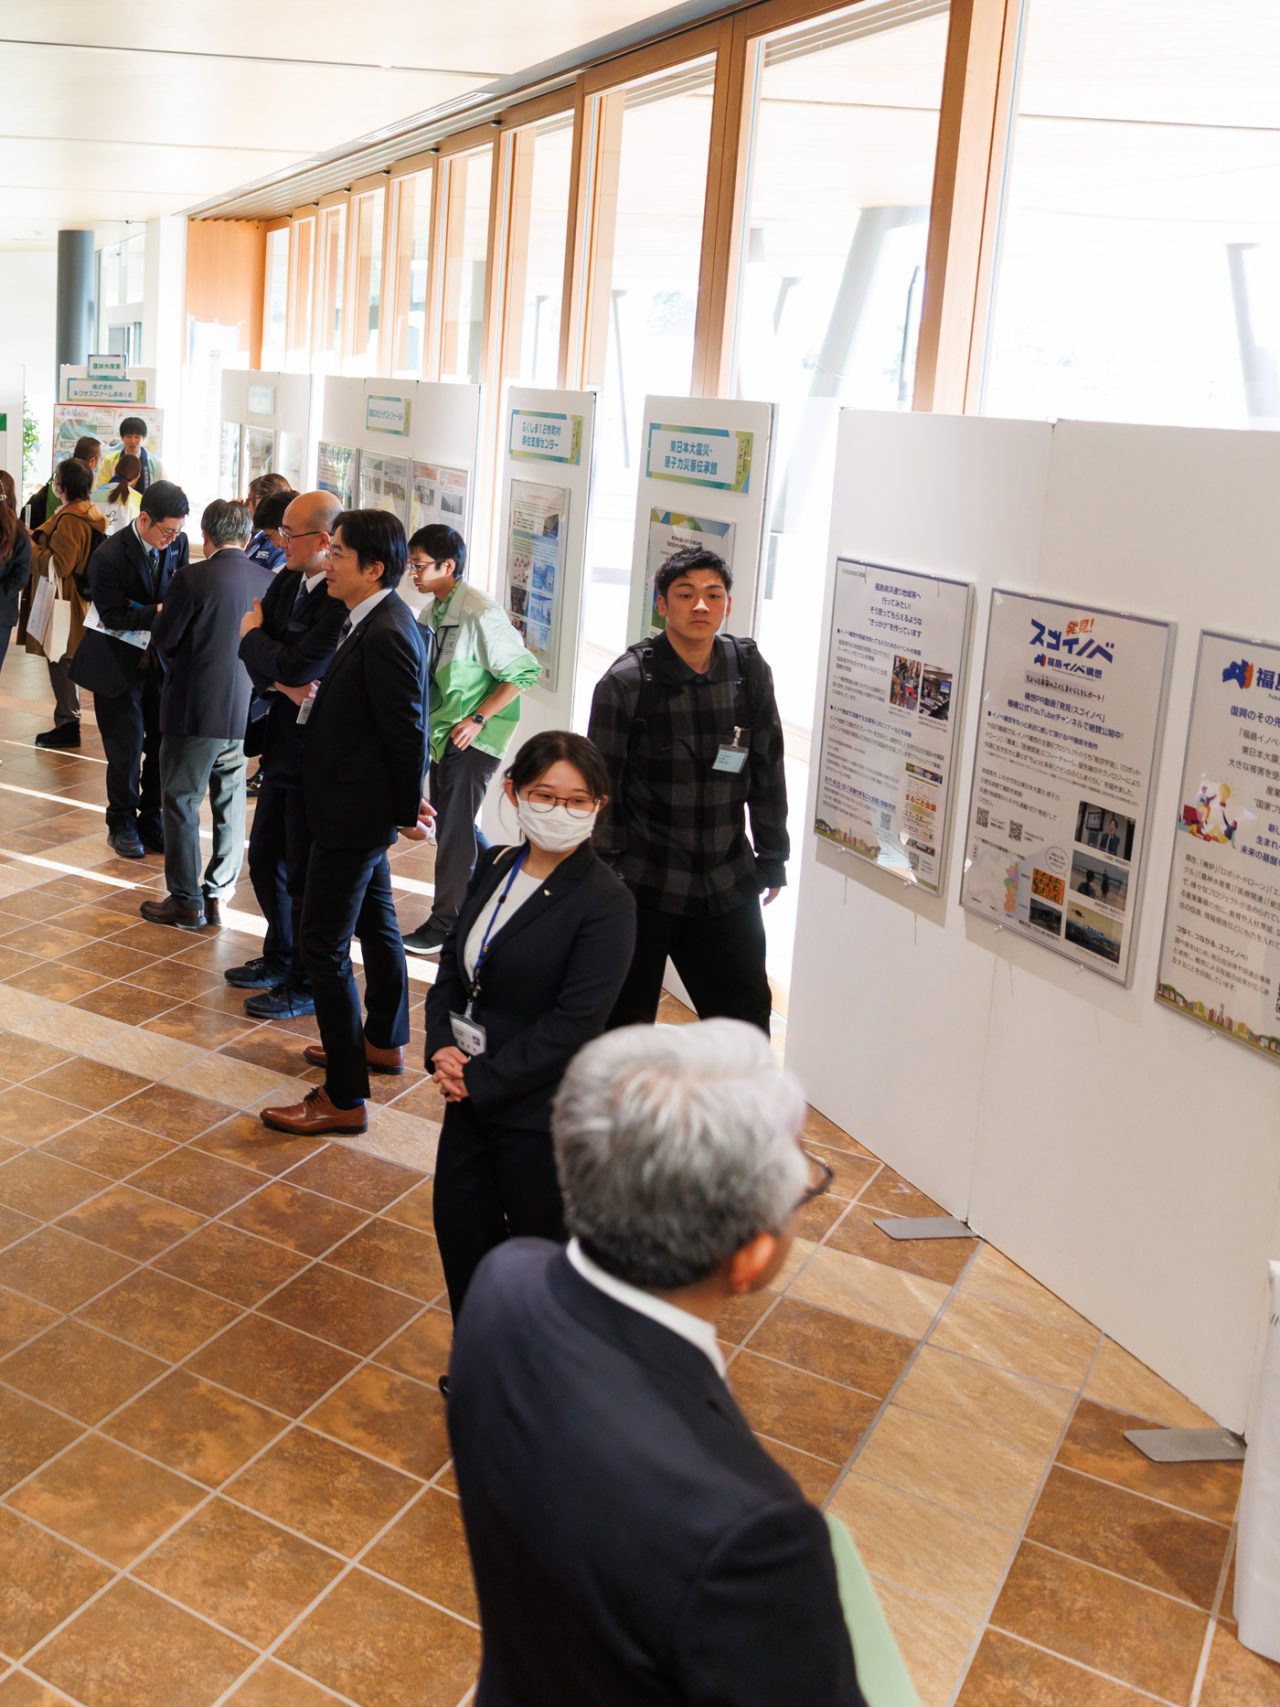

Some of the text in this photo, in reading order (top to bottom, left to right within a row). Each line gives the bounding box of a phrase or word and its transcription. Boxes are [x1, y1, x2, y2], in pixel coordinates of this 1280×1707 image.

[664, 455, 718, 475] 原子力災害伝承館
[870, 606, 923, 626] そう思ってもらえるような
[1065, 618, 1095, 636] 発見!
[1029, 618, 1115, 664] スゴイノベ
[1047, 657, 1103, 679] 福島イノベ構想
[1256, 667, 1280, 691] 福
[1230, 705, 1280, 728] 復興のその先
[1239, 728, 1280, 746] 「福島イノベ
[1242, 745, 1280, 765] 東日本大震
[1256, 835, 1280, 850] 生まれ
[1241, 845, 1280, 867] 未来の基盤
